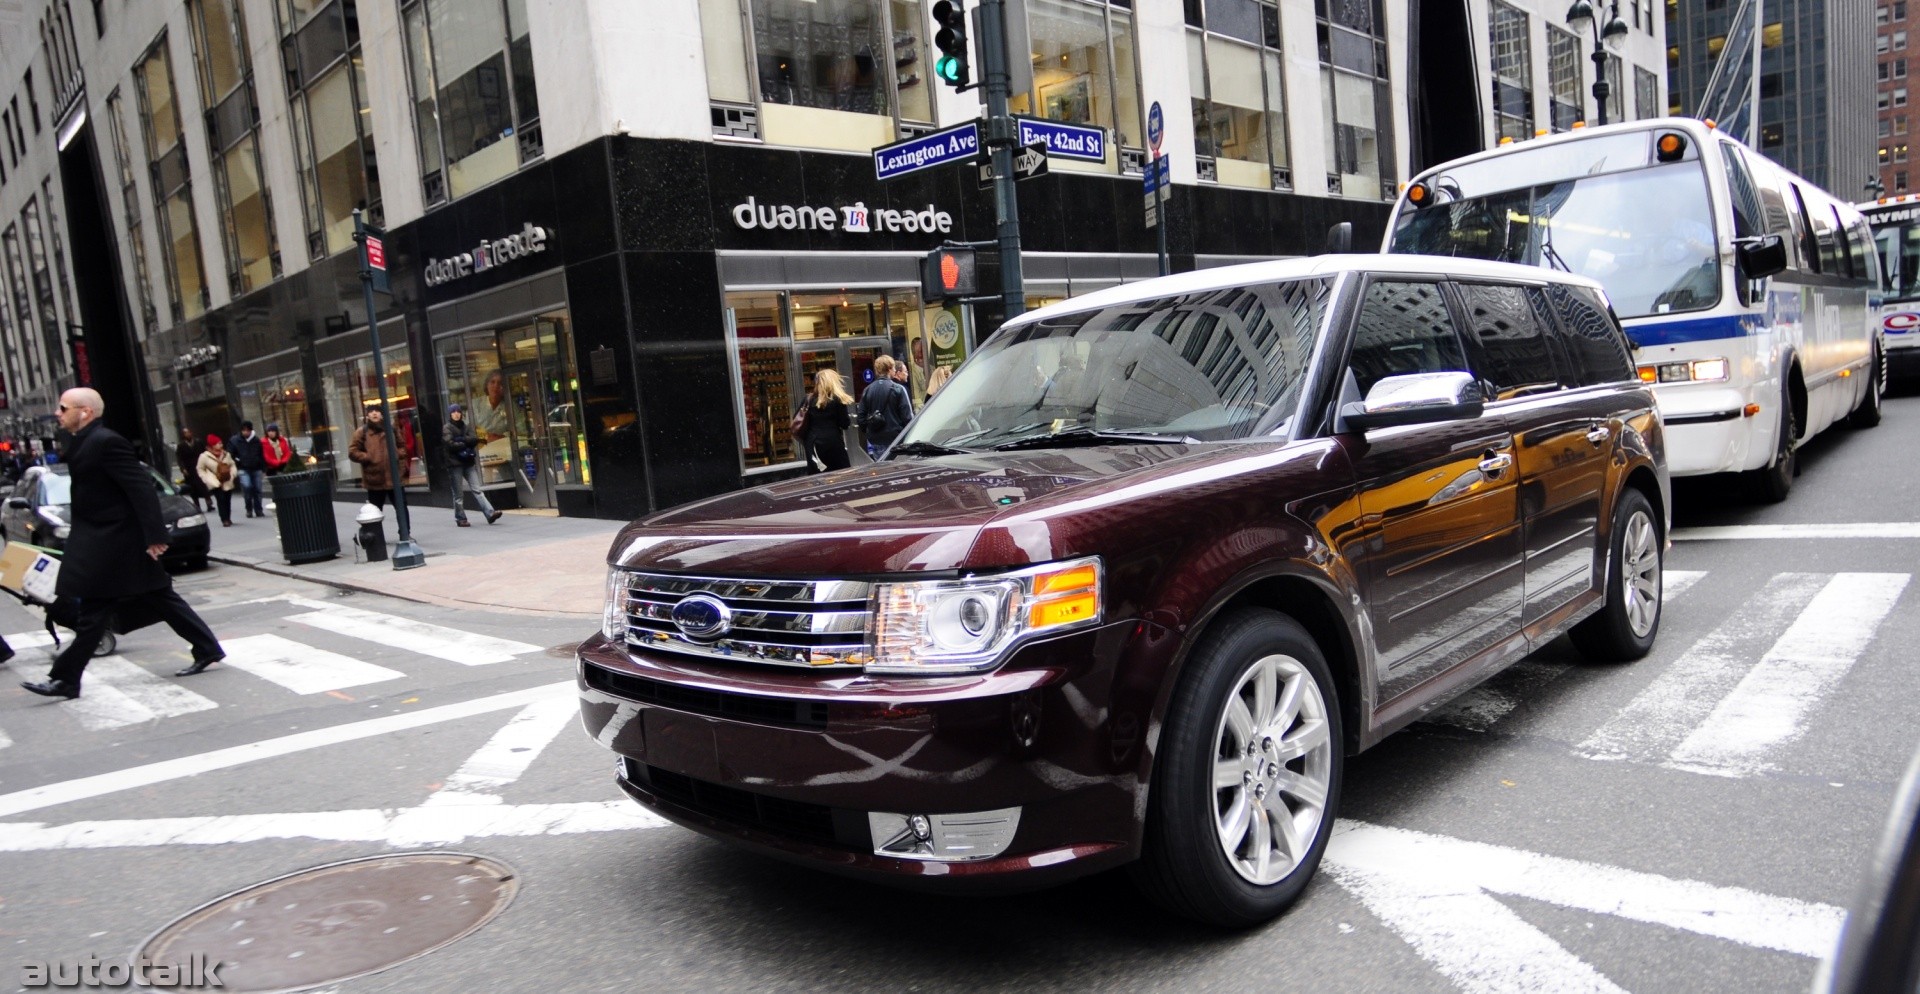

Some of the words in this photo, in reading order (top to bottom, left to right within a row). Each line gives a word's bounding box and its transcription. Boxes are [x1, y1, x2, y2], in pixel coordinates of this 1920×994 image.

[878, 143, 946, 172] Lexington
[948, 135, 976, 154] Ave
[1022, 127, 1052, 148] East
[1053, 132, 1084, 152] 42nd
[1086, 135, 1100, 154] St
[1017, 153, 1037, 170] WAY
[733, 196, 837, 231] duane
[873, 204, 953, 234] reade
[424, 258, 473, 288] duane
[491, 222, 547, 266] reade
